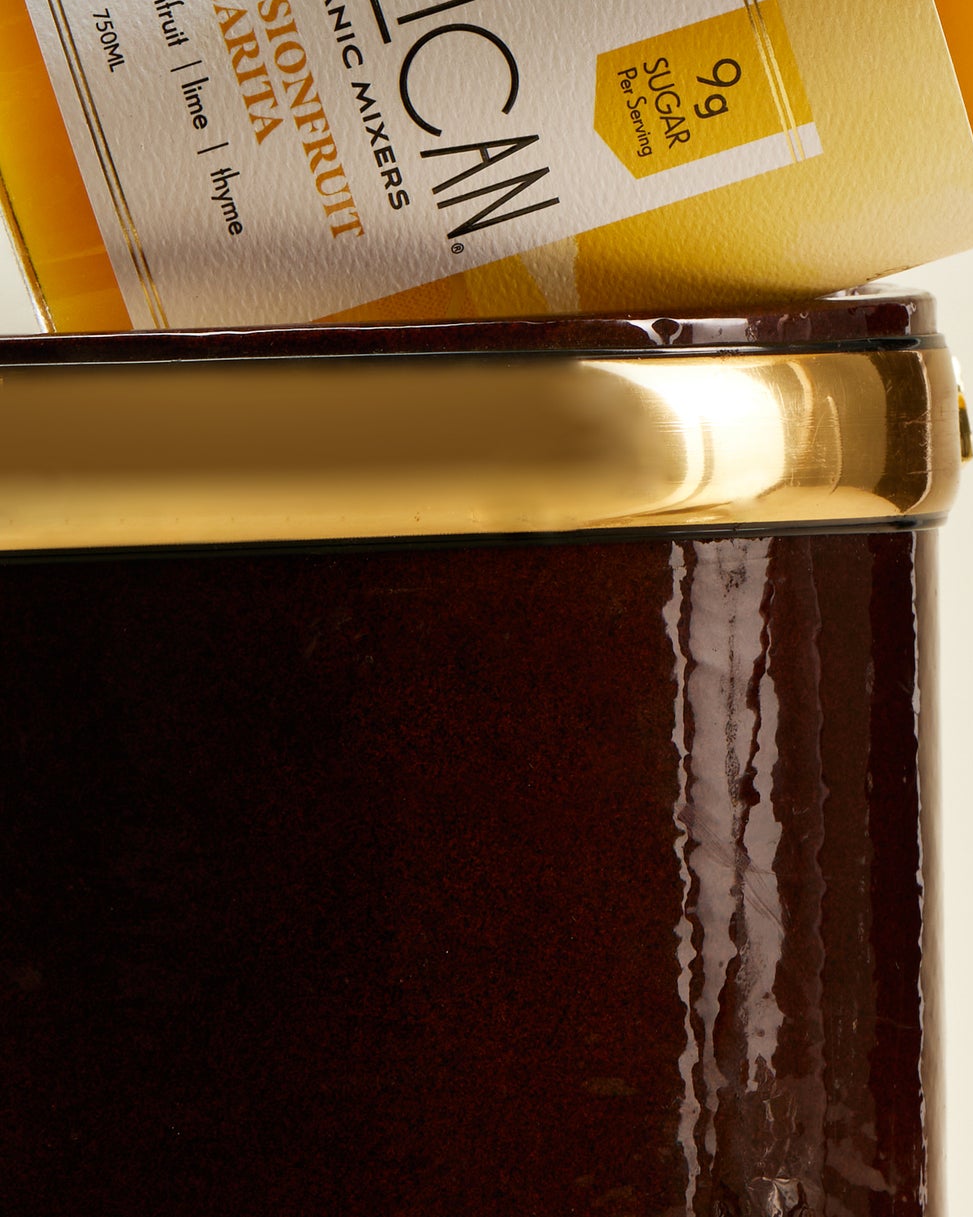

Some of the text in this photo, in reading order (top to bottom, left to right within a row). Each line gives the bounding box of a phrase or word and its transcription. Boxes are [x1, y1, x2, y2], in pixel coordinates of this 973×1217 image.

[93, 8, 124, 73] 750ML
[617, 67, 652, 157] Per Serving
[643, 57, 690, 149] SUGAR
[694, 58, 741, 119] 9g
[181, 77, 209, 130] lime
[210, 168, 242, 236] thyme
[351, 82, 410, 210] MIXERS
